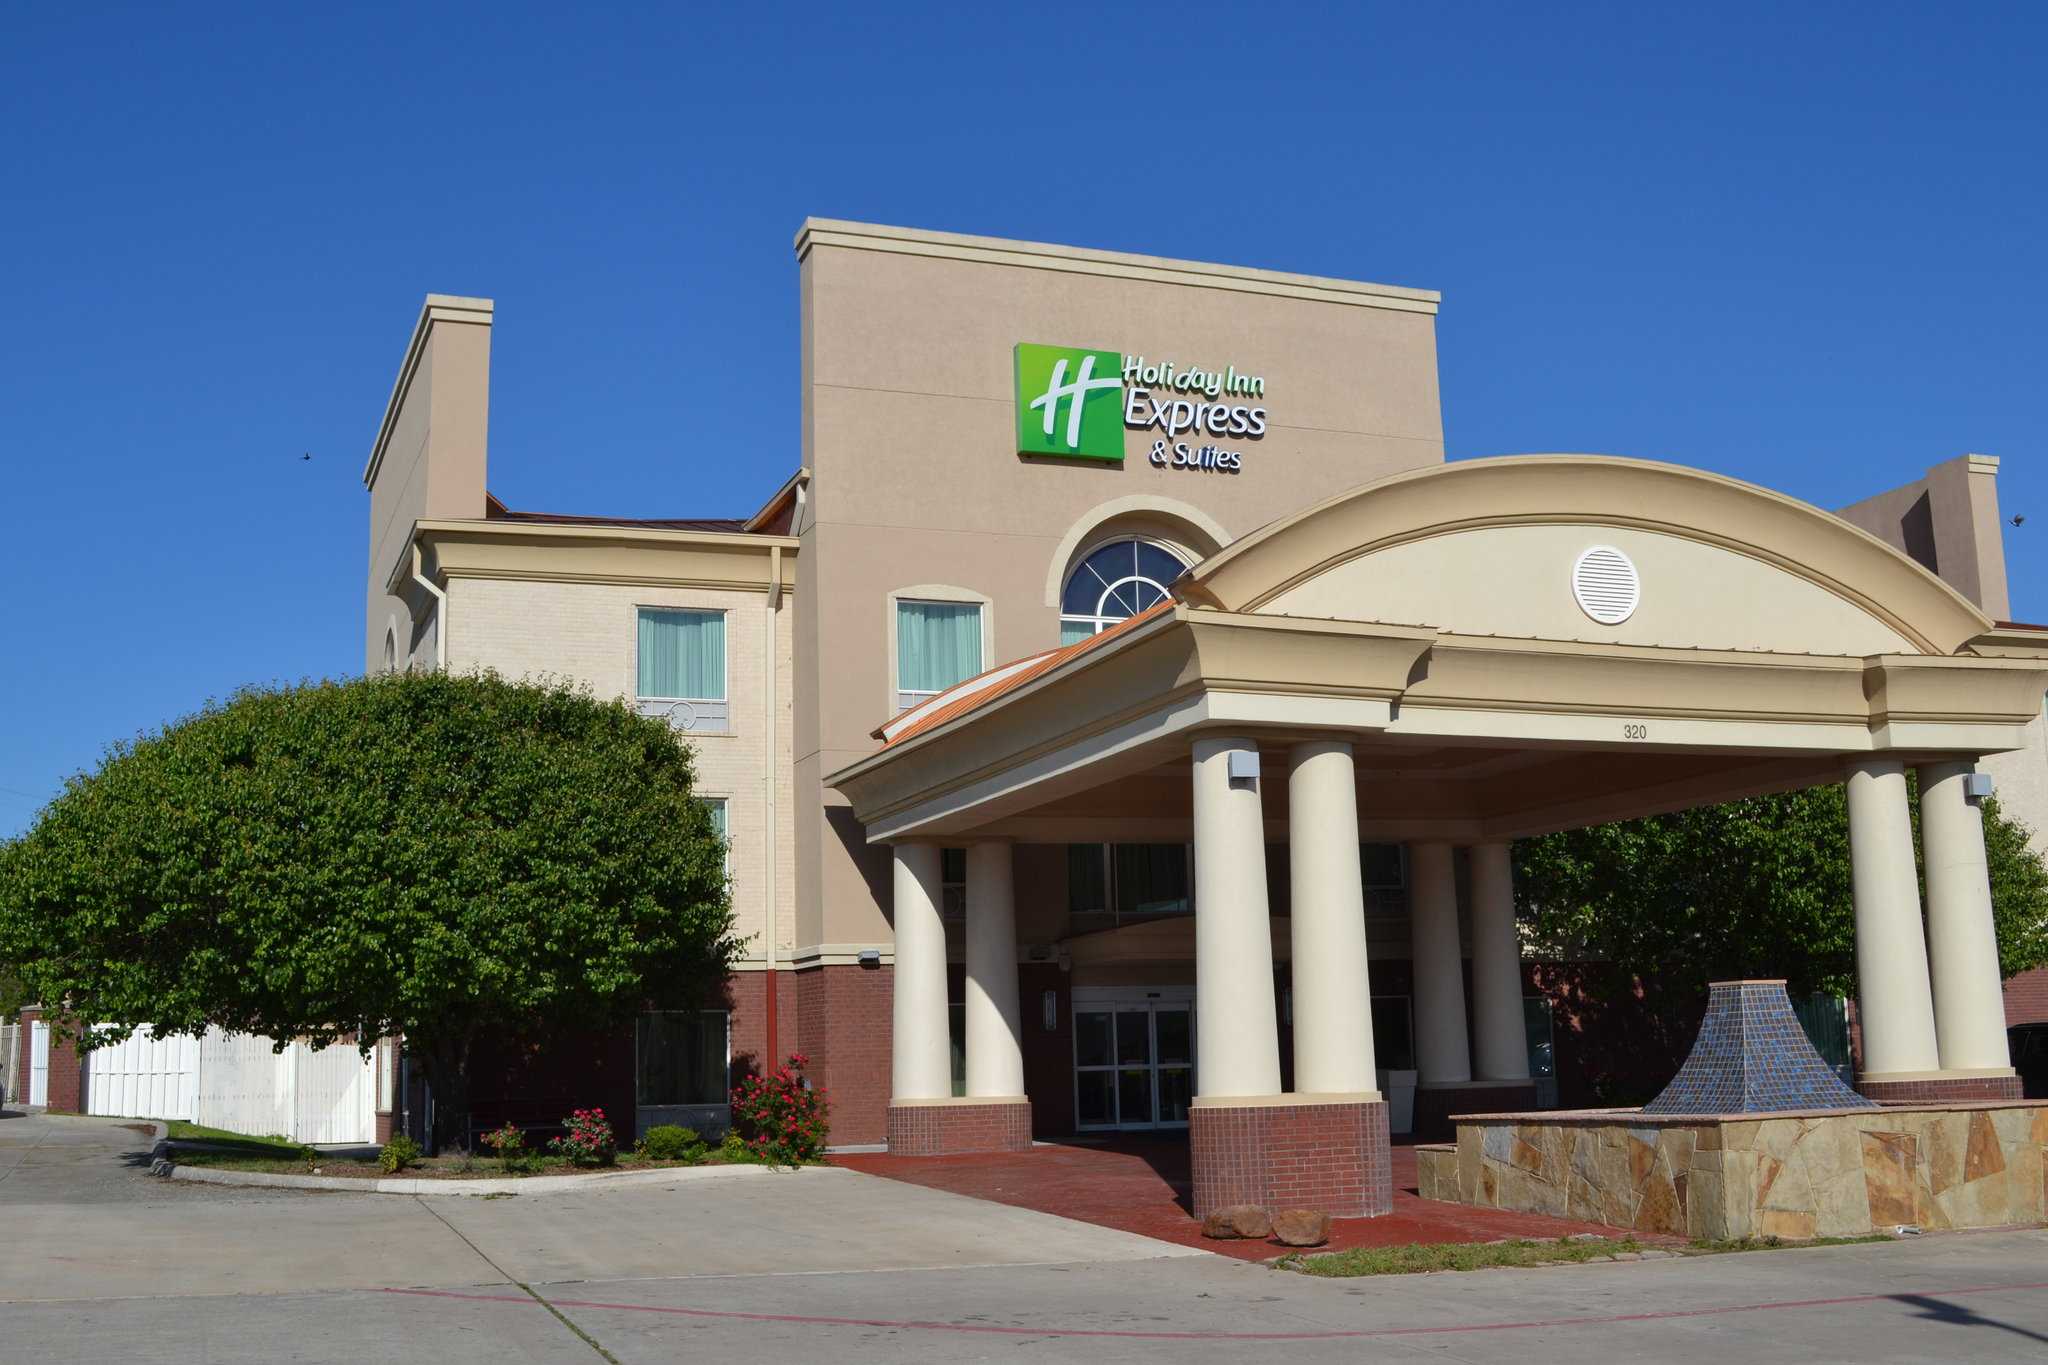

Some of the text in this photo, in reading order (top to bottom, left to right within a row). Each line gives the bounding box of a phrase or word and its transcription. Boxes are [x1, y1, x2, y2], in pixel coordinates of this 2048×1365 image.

[1121, 355, 1265, 396] Holiday Inn
[1125, 388, 1266, 439] Express
[1151, 441, 1241, 469] & Suites
[1624, 725, 1646, 739] 320
